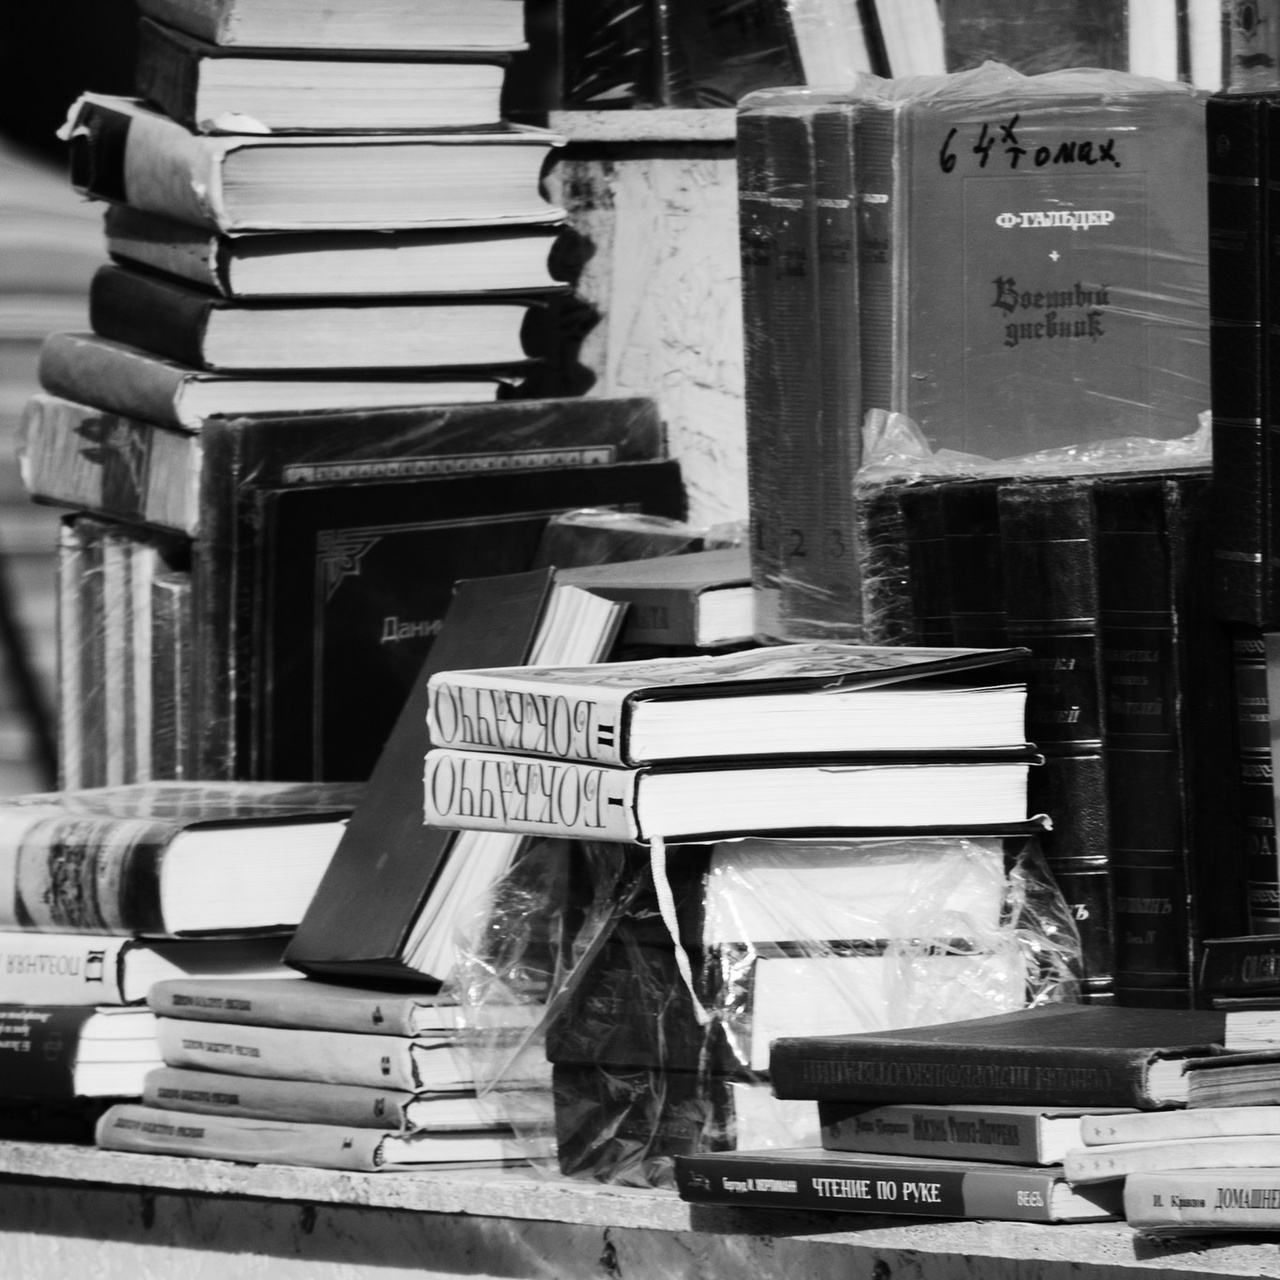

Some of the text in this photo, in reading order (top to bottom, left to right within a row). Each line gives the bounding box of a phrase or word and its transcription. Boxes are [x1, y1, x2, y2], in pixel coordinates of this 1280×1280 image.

[380, 615, 441, 645] Дани
[434, 682, 597, 760] БОККАЧЧО
[431, 755, 609, 828] БОККАЧЧО
[812, 1178, 871, 1199] ЧТЕНИЕ
[876, 1181, 897, 1200] ПО
[902, 1181, 941, 1203] РУКЕ
